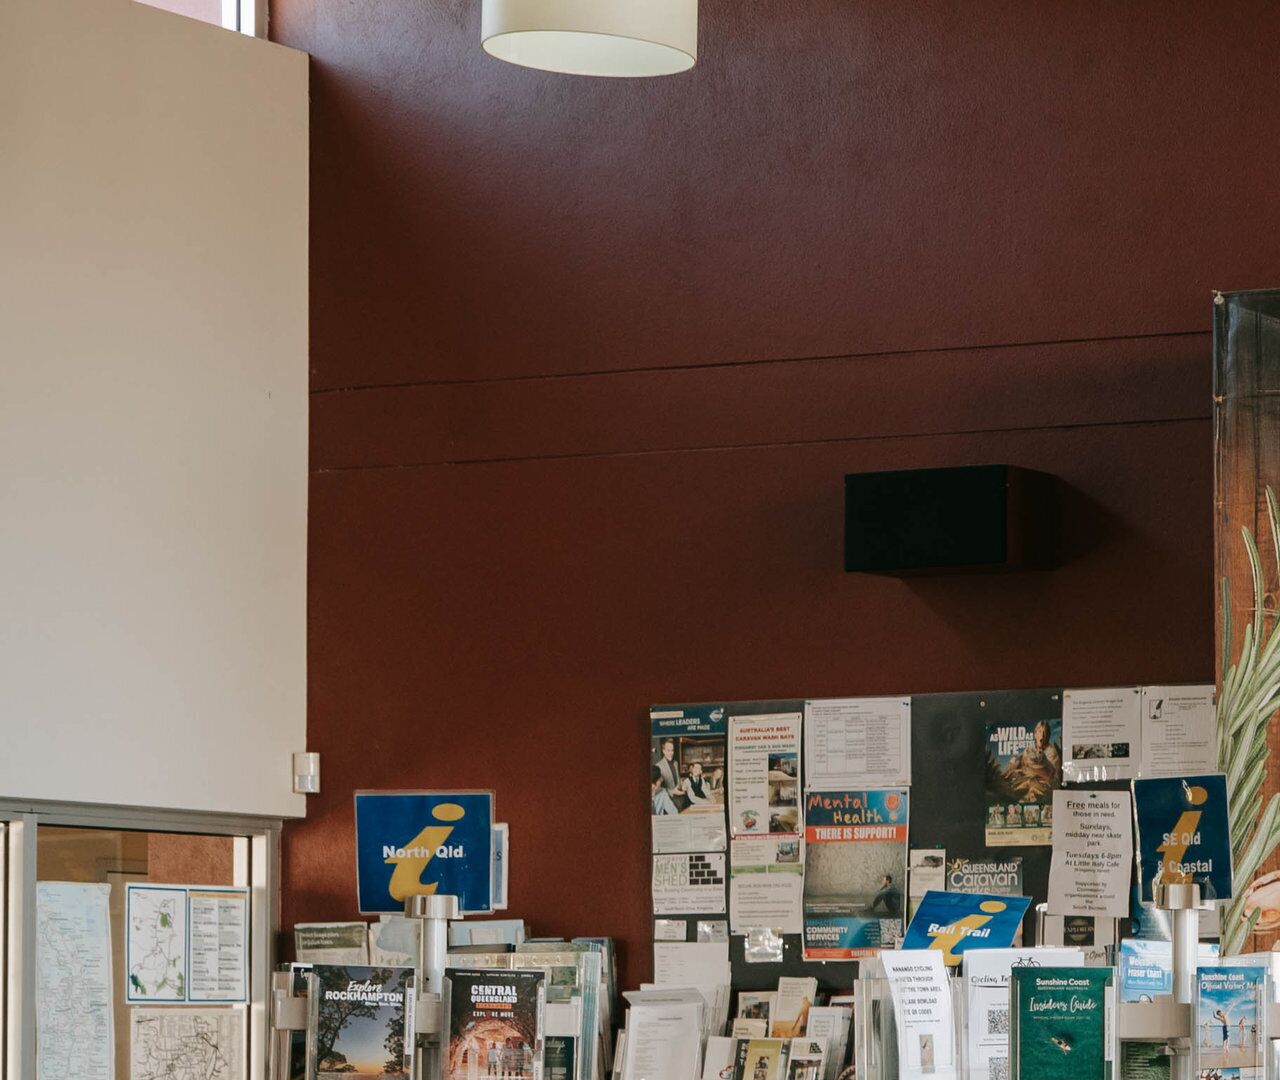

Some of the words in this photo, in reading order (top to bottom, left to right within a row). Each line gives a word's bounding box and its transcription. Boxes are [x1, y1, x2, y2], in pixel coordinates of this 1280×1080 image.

[676, 718, 700, 726] LEADERS
[998, 726, 1025, 741] WILD
[998, 741, 1019, 756] LIFE
[808, 795, 868, 811] Mental
[1066, 801, 1085, 810] Free
[1088, 801, 1110, 809] meals
[1111, 801, 1120, 809] for
[833, 809, 884, 825] Health
[815, 828, 841, 840] THERE
[843, 827, 852, 839] IS
[853, 826, 897, 839] SUPPORT!
[1162, 832, 1178, 845] SE
[1181, 832, 1200, 845] Qld
[382, 845, 430, 858] North
[435, 845, 464, 859] Qld
[655, 862, 687, 874] MEN'S
[961, 862, 1018, 874] QUEENSLAND
[1168, 859, 1212, 873] Coastal
[655, 875, 687, 886] SHED
[950, 872, 1018, 886] Caravan
[806, 926, 848, 934] COMMUNITY
[928, 923, 955, 936] Rail
[960, 926, 990, 938] Trail
[806, 934, 840, 942] SERVICES
[971, 975, 998, 984] Cycling
[1035, 978, 1067, 987] Sunshine
[1069, 978, 1090, 987] Coast
[1201, 973, 1228, 981] Sunshine
[347, 980, 383, 993] Explore
[471, 985, 517, 996] CENTRAL
[325, 991, 404, 1002] ROCKHAMPTON
[470, 995, 518, 1004] QUEENSLAND
